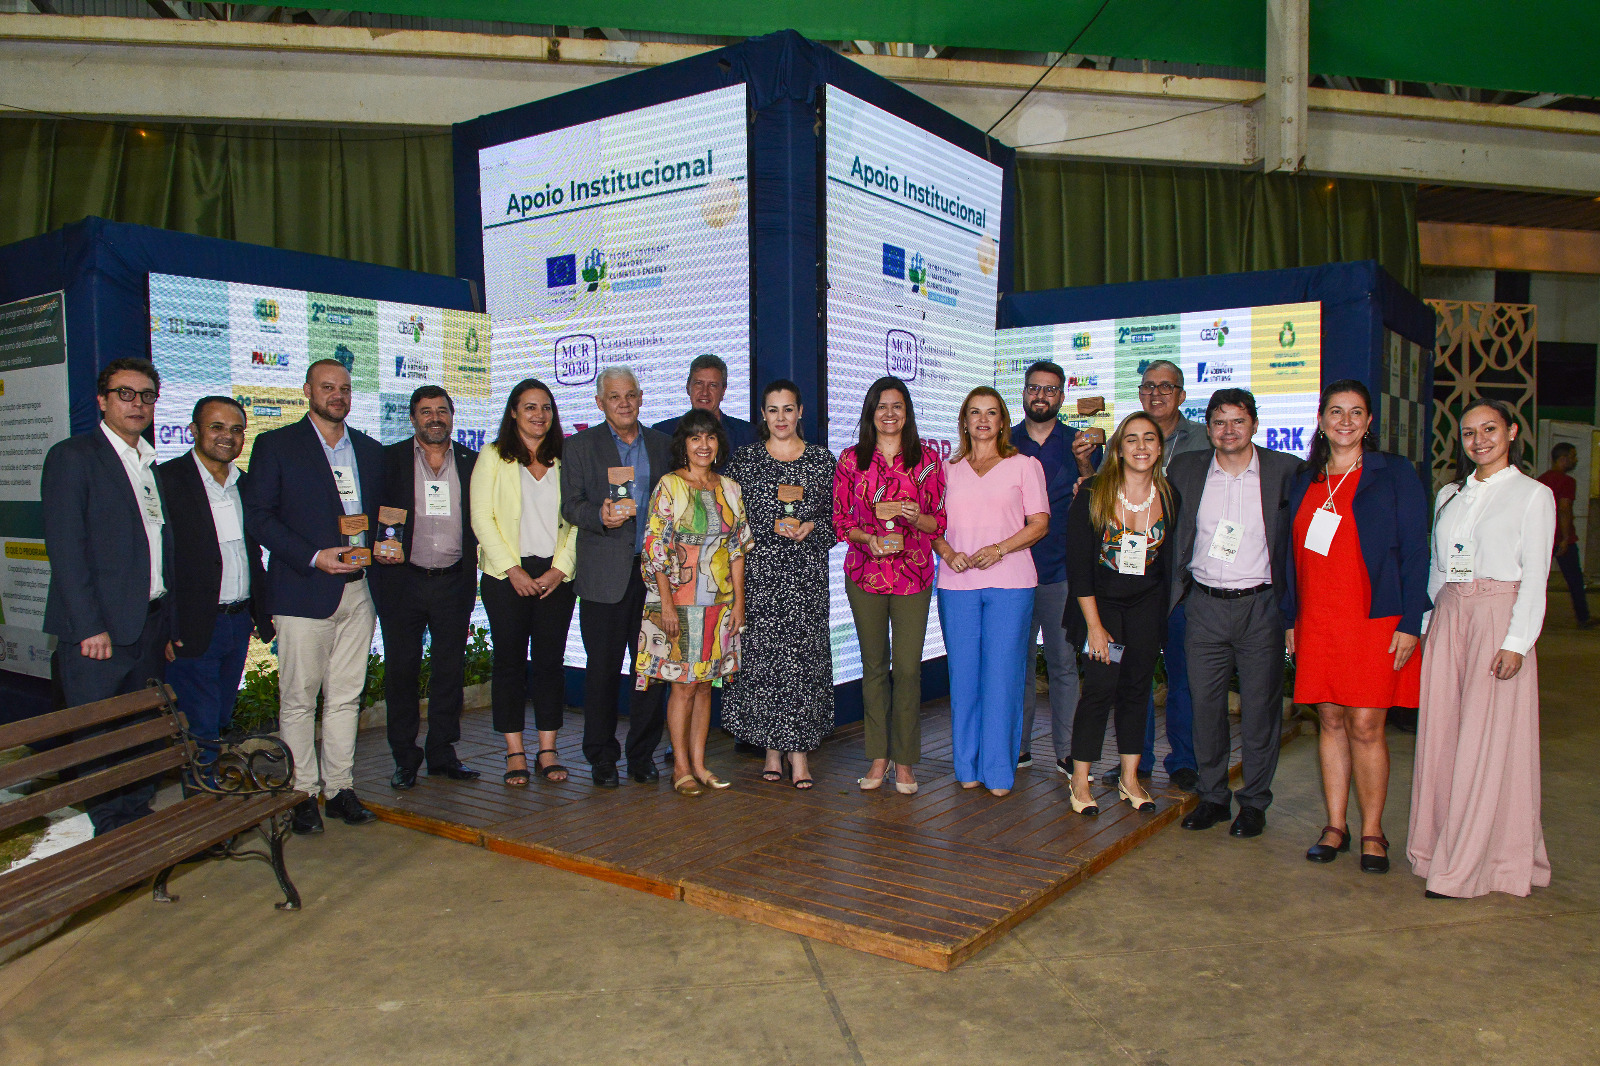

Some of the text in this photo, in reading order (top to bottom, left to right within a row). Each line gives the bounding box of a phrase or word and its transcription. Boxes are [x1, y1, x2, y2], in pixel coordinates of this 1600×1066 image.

[506, 149, 713, 217] Apoio Institucional
[850, 155, 986, 228] Apoio Institucional
[561, 343, 589, 359] MCR
[891, 338, 912, 355] MCR
[562, 360, 589, 377] 2030
[891, 355, 912, 373] 2030
[159, 425, 195, 445] ene
[457, 429, 486, 452] BRK
[1266, 427, 1304, 451] BRK
